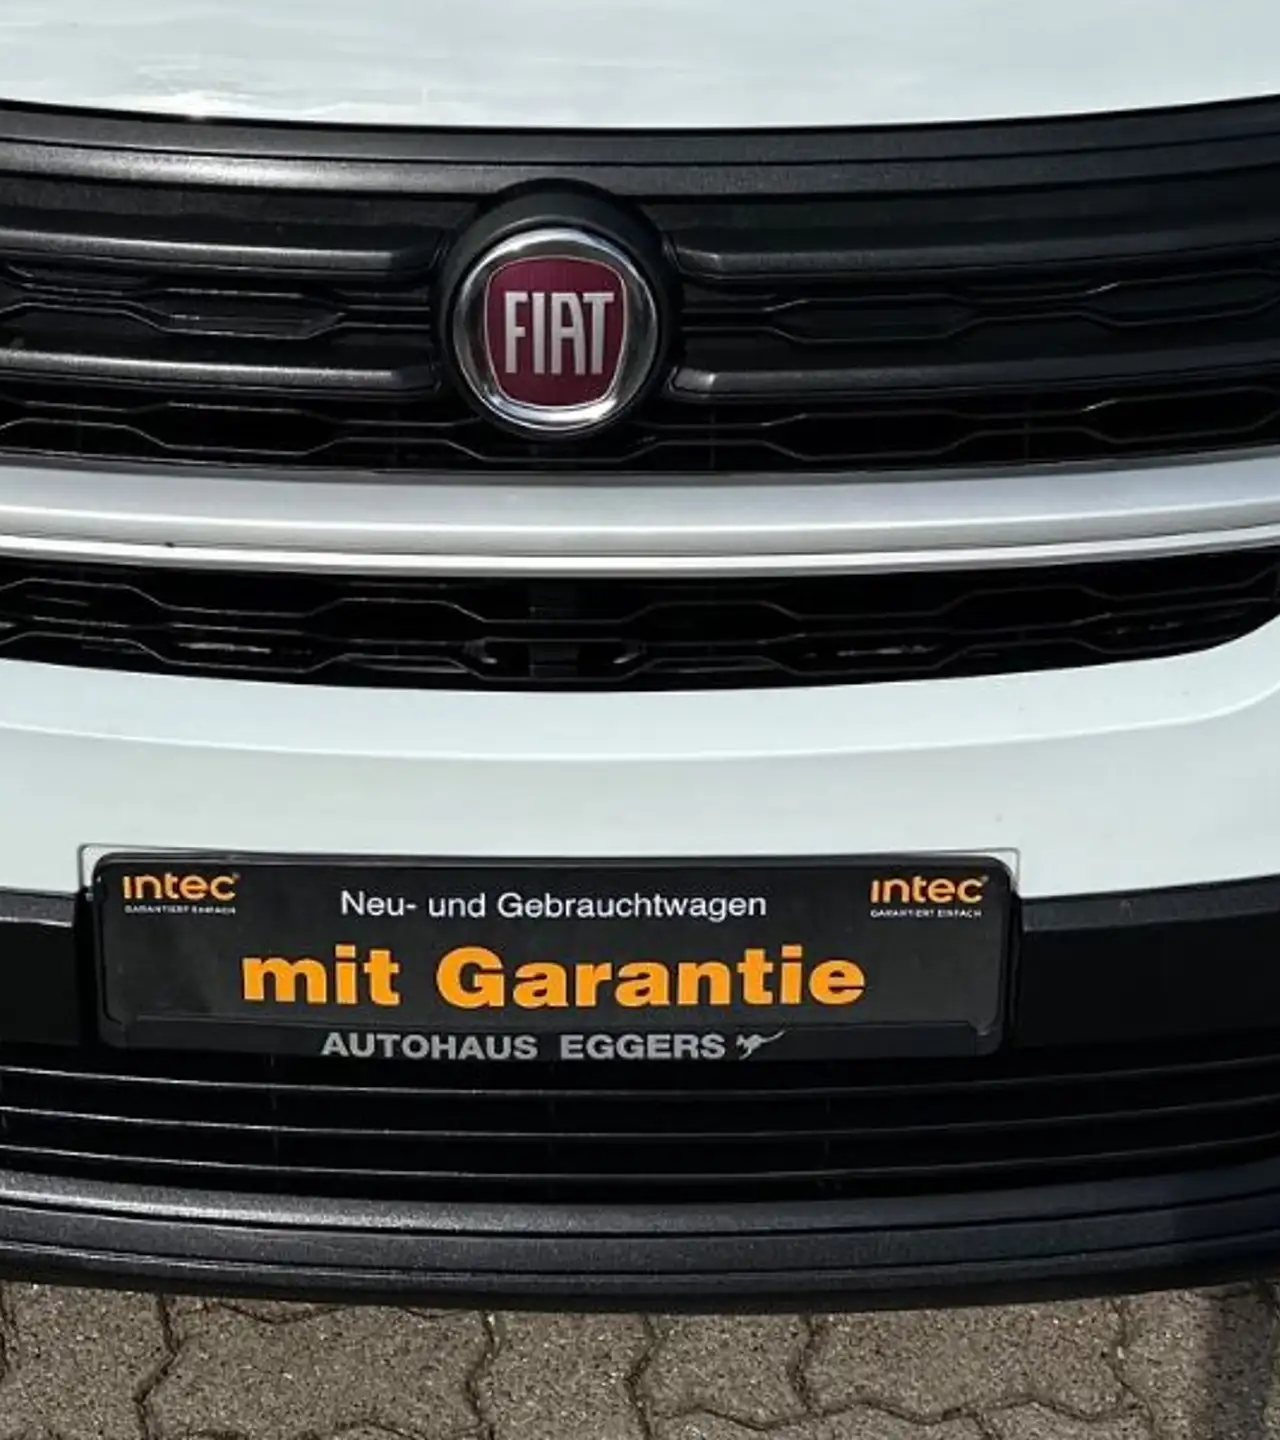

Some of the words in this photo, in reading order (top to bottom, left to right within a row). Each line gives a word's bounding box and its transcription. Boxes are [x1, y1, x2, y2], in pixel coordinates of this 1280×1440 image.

[505, 291, 615, 376] FIAT
[123, 872, 236, 900] intec
[870, 876, 983, 903] intec
[341, 890, 417, 918] Neu-
[428, 892, 486, 918] und
[497, 892, 767, 923] Gebrauchtwagen
[242, 944, 401, 1006] mit
[436, 944, 866, 1009] Garantie
[321, 1032, 538, 1060] AUTOHAUS
[560, 1033, 726, 1060] EGGERS
